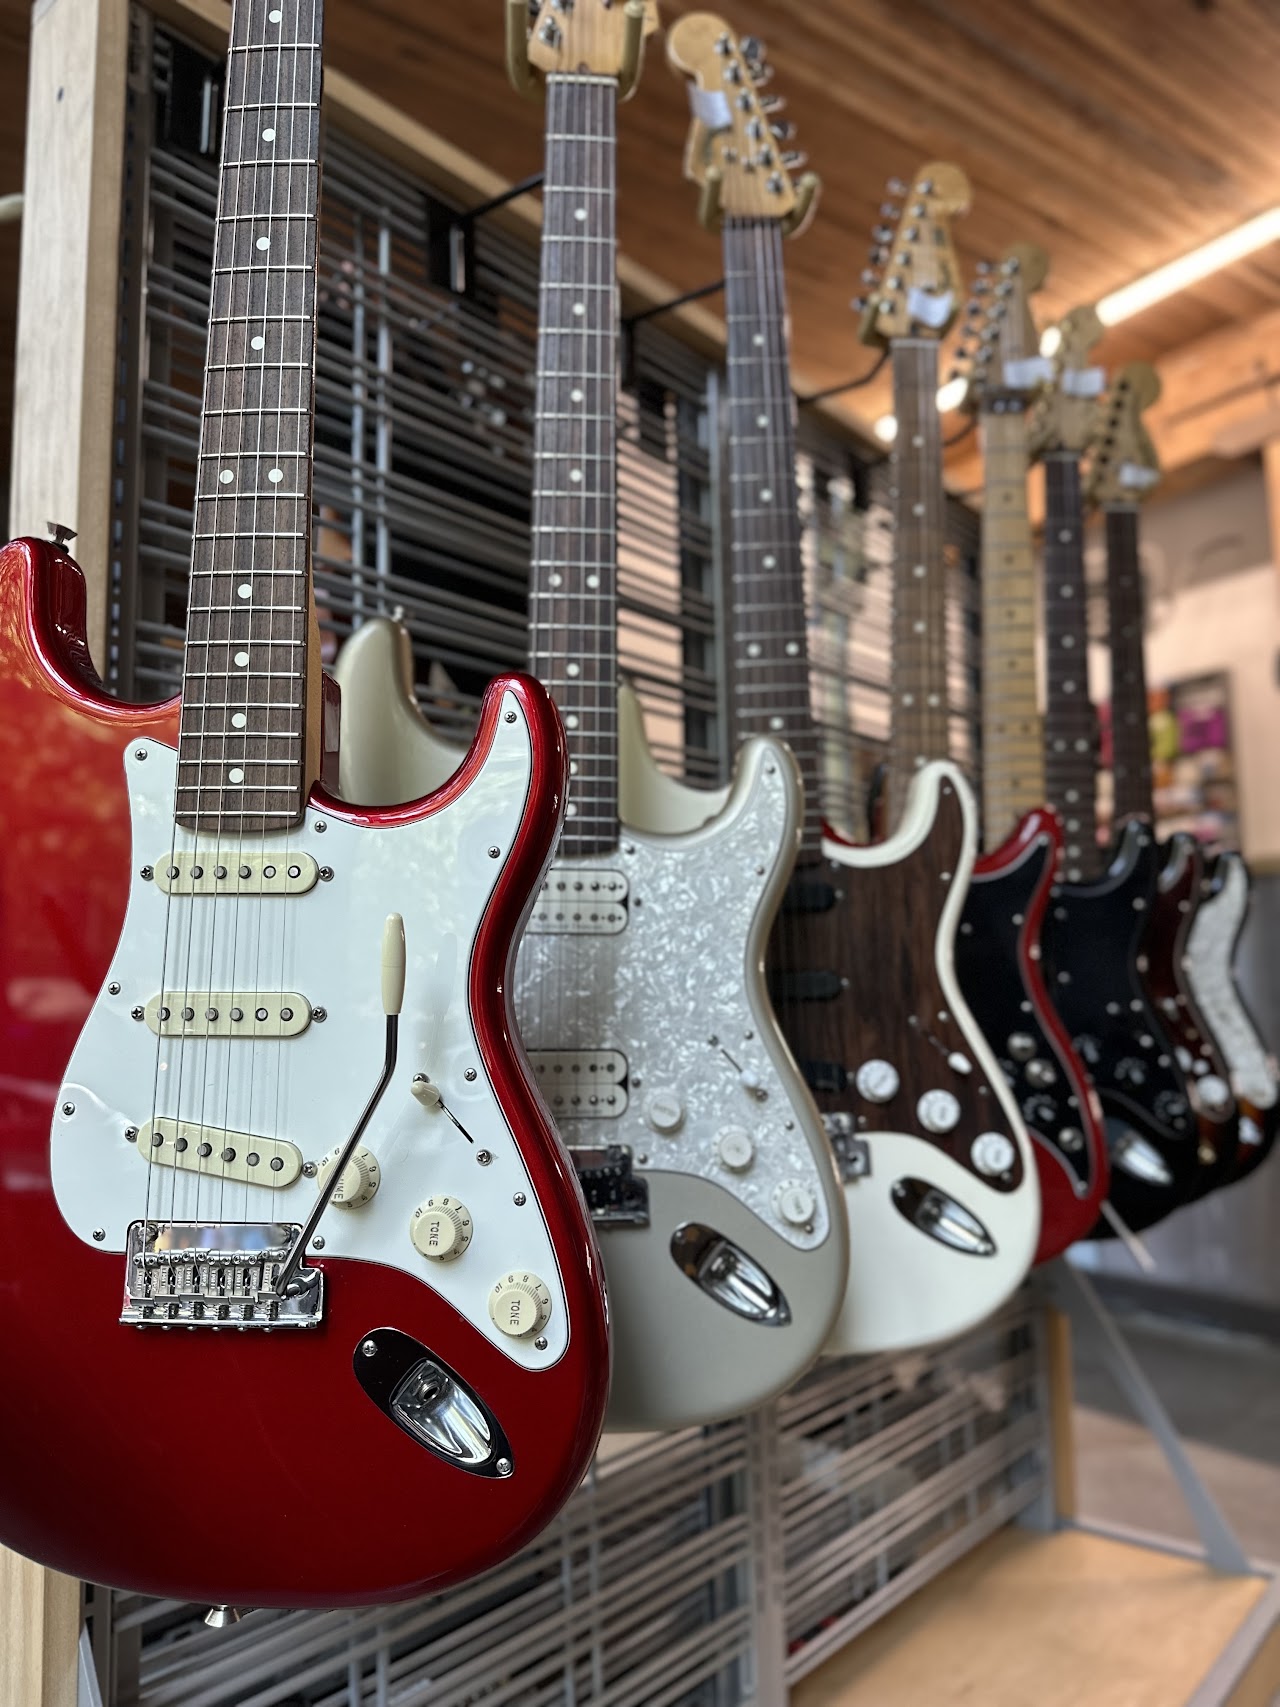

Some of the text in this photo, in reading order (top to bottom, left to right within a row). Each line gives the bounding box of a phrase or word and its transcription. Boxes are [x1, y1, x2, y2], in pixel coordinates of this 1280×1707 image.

[361, 1152, 369, 1161] 7
[368, 1165, 377, 1173] 6
[427, 1199, 434, 1207] 9
[442, 1197, 450, 1206] 8
[454, 1205, 463, 1214] 7
[462, 1219, 470, 1227] 6
[429, 1221, 440, 1246] TONE
[507, 1274, 514, 1284] 9
[522, 1274, 529, 1283] 8
[535, 1283, 542, 1292] 7
[509, 1299, 521, 1326] TONE
